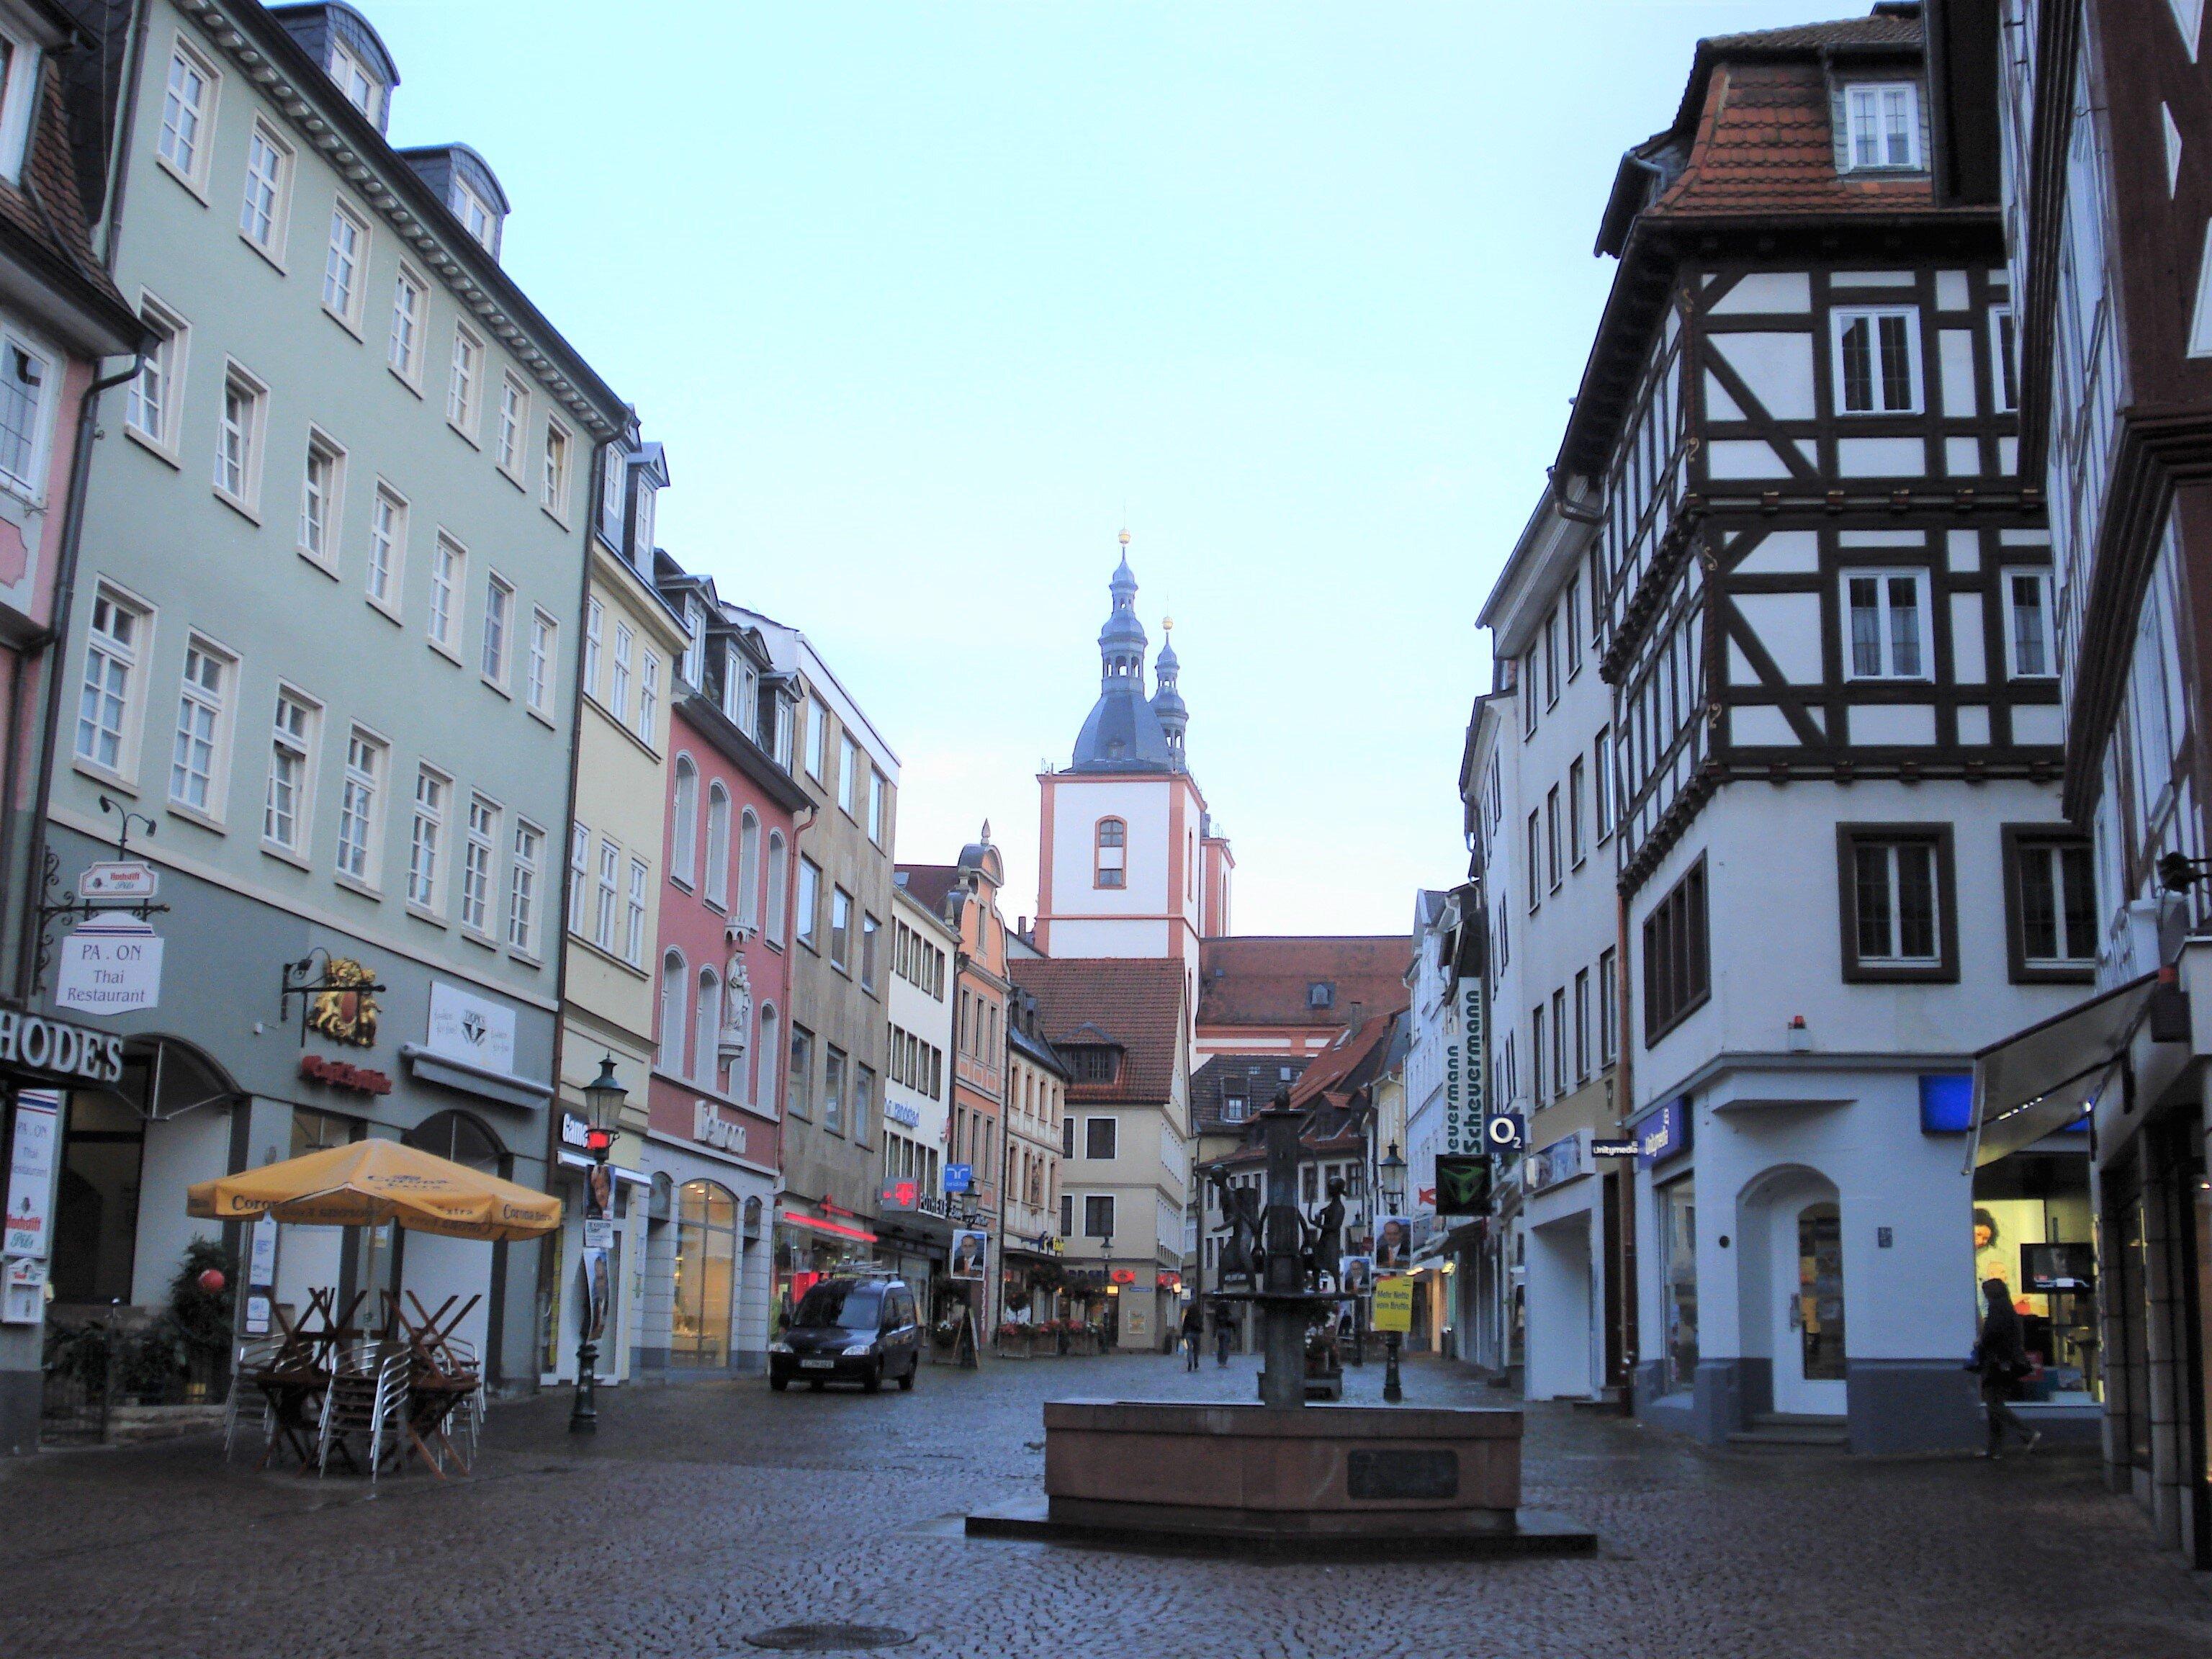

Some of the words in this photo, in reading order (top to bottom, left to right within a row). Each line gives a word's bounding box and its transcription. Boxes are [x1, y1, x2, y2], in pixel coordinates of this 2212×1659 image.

[94, 970, 125, 984] Thai
[67, 987, 147, 1002] Restaurant
[1463, 989, 1482, 1154] Scheuermann
[1447, 1046, 1459, 1155] euermann
[1593, 1145, 1638, 1156] Unitymedia
